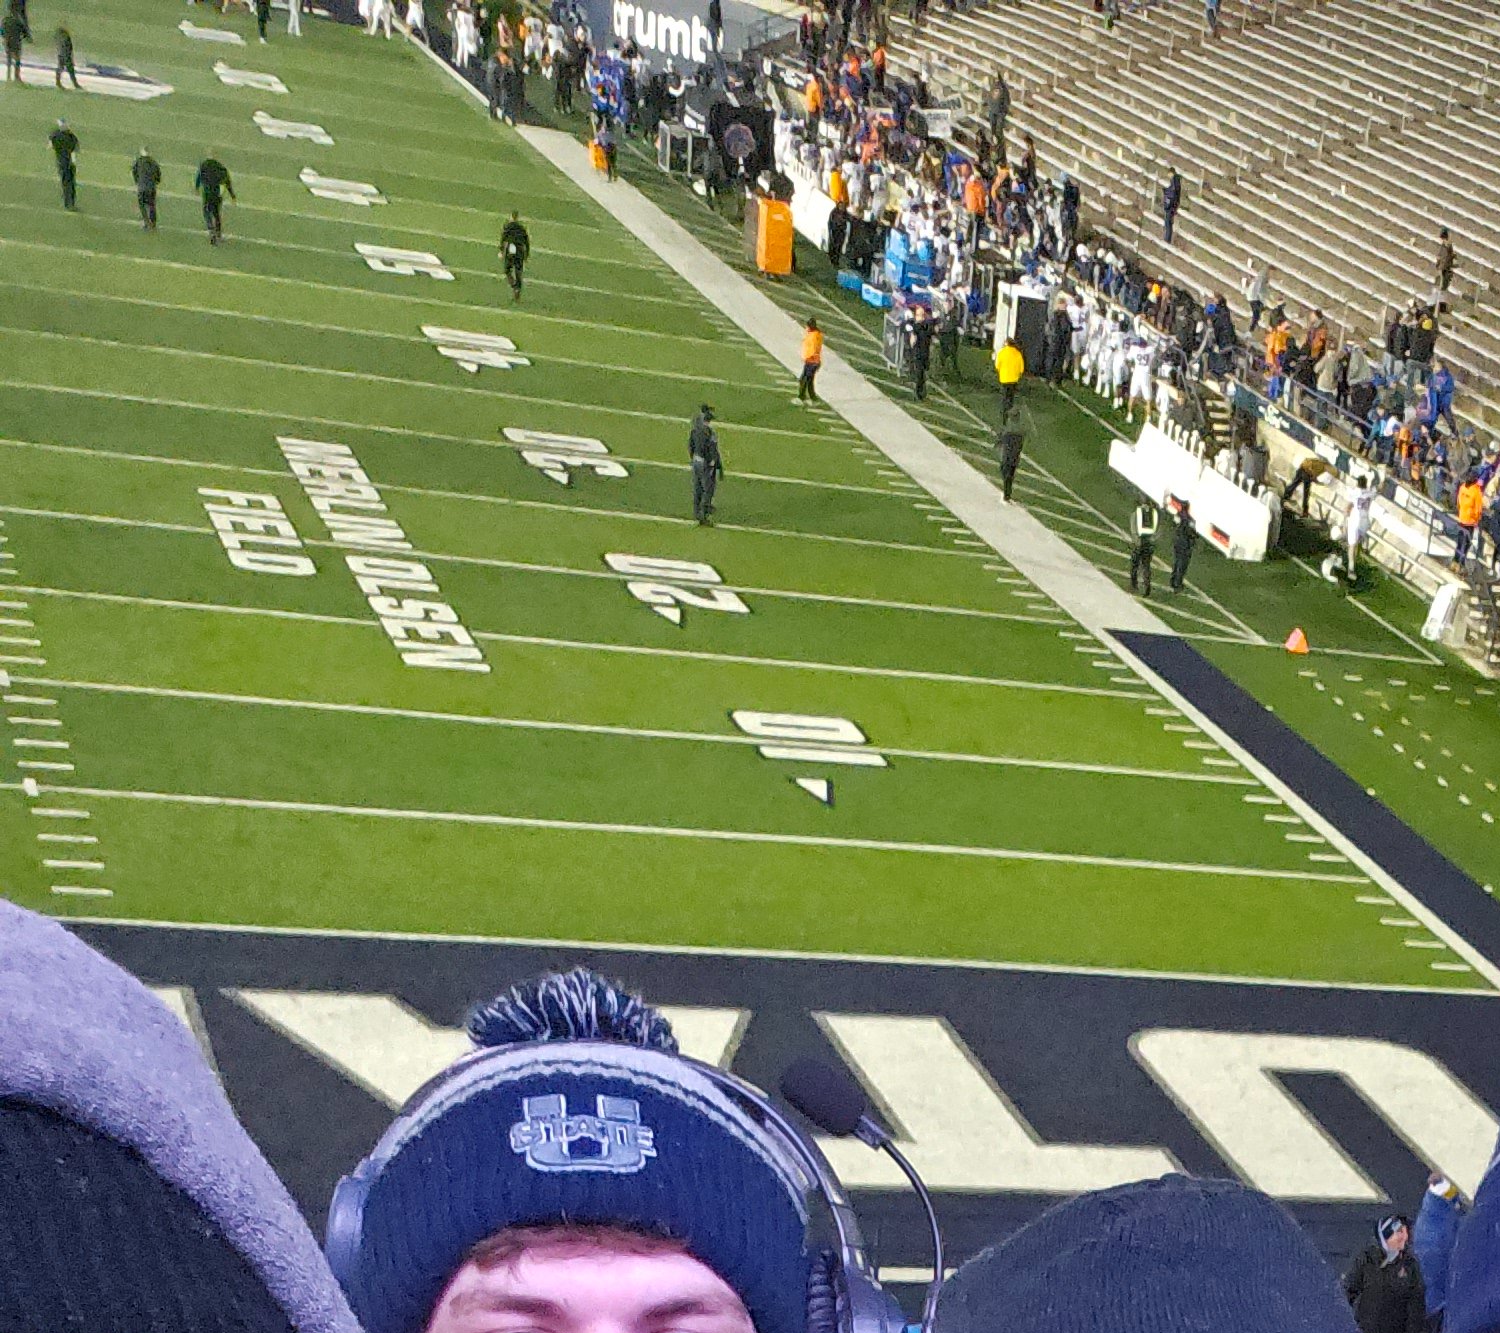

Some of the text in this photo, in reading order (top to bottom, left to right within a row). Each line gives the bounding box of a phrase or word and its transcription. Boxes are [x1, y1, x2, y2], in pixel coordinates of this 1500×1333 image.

[197, 486, 317, 576] FIELD
[275, 436, 491, 673] MERLIN OLSEN
[603, 552, 751, 614] 20
